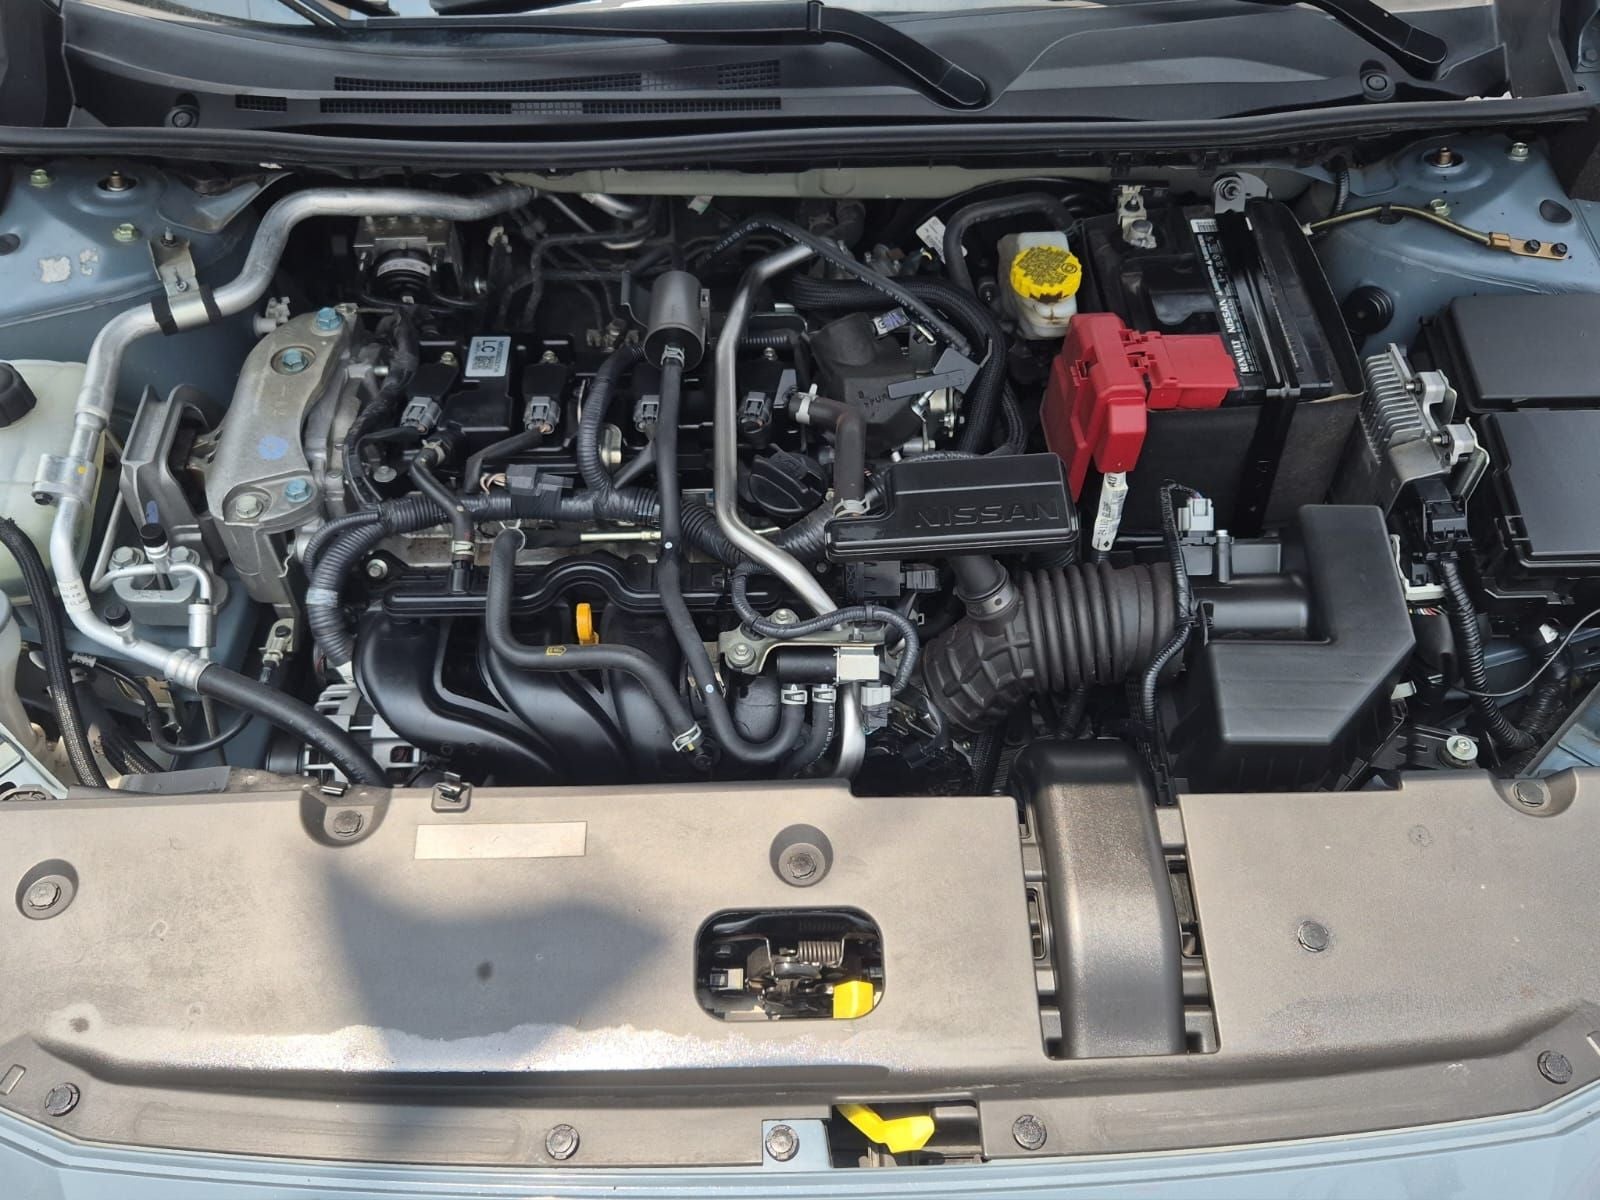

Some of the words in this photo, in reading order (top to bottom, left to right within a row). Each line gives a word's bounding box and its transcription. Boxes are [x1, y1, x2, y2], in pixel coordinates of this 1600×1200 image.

[1219, 299, 1237, 333] NISSAN
[1231, 339, 1250, 373] RENAULT
[914, 501, 1060, 528] NISSAN
